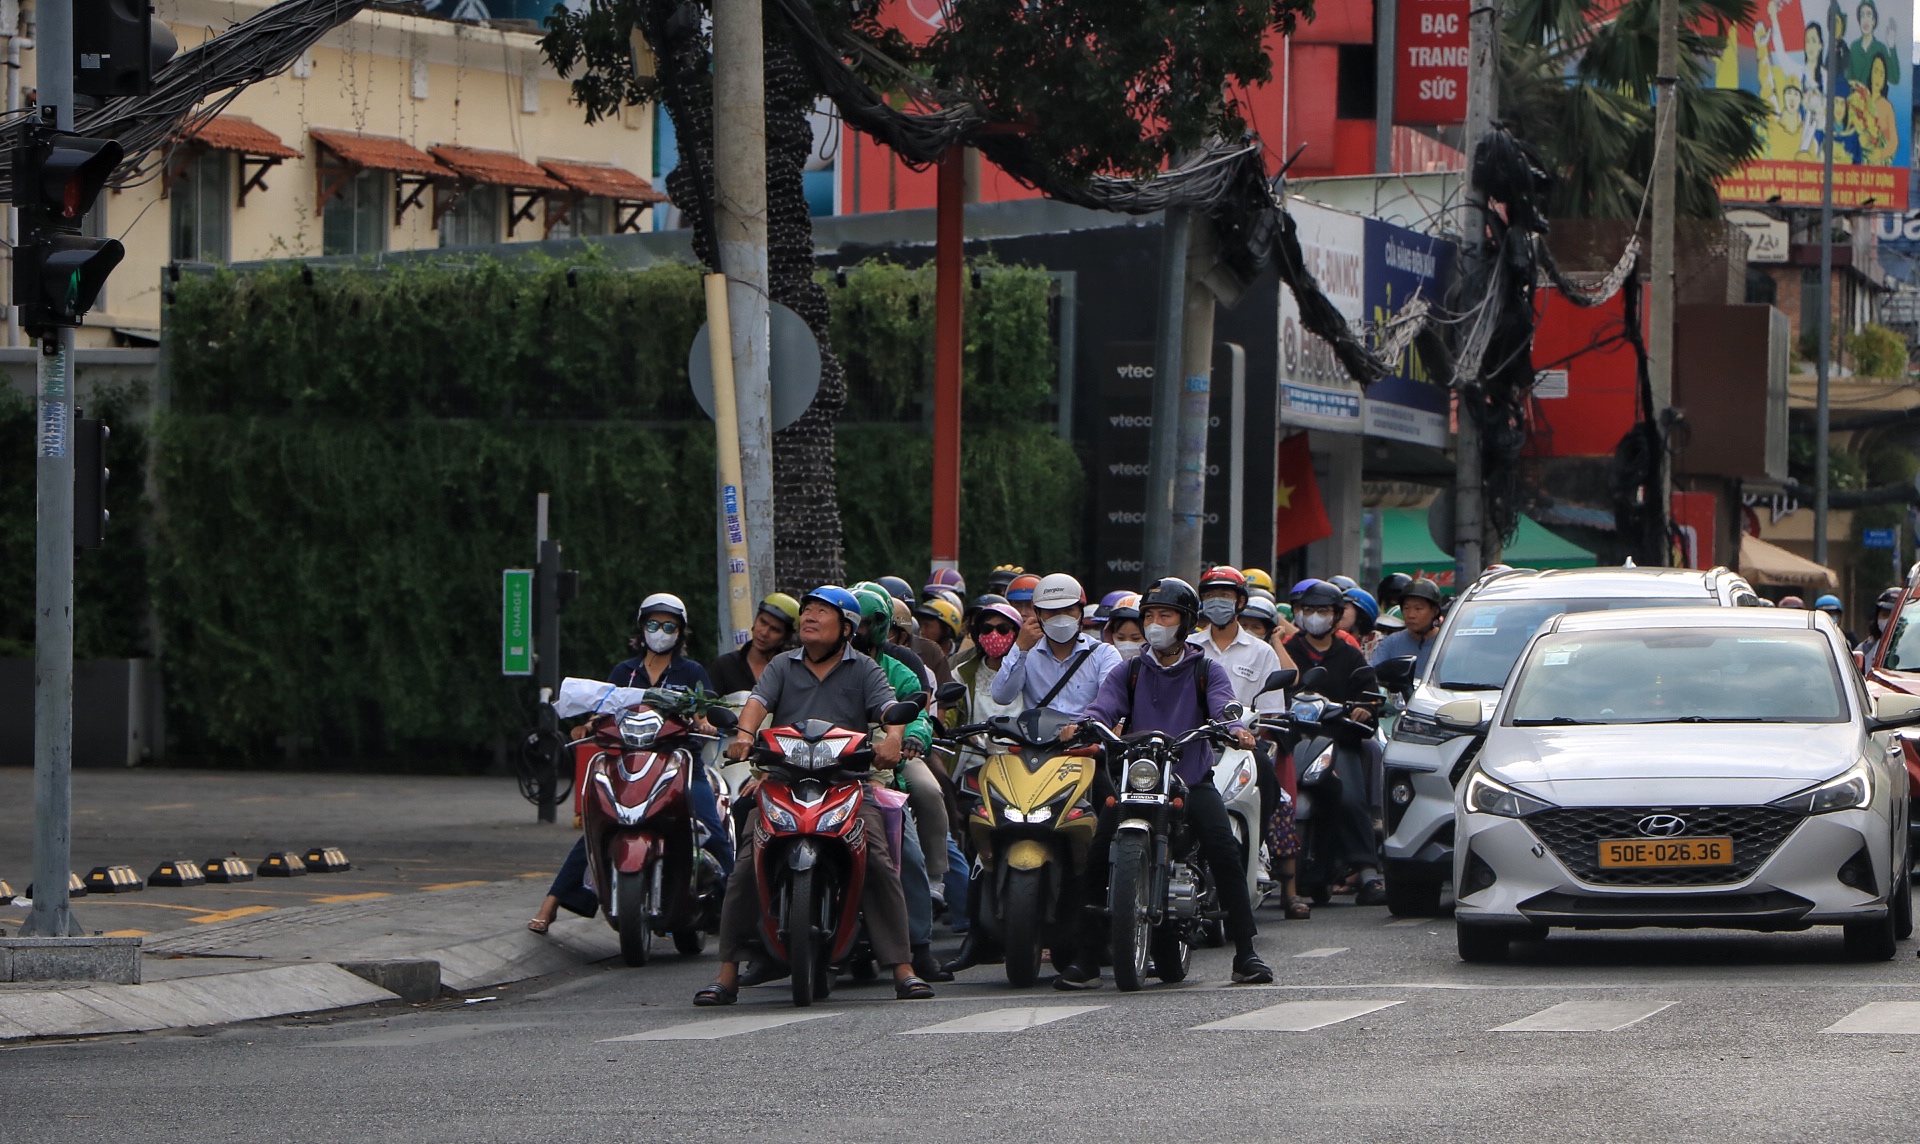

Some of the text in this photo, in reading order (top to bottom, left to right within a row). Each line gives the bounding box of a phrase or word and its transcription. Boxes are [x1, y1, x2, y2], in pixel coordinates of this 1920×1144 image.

[1421, 13, 1458, 38] BẠC
[1408, 46, 1468, 67] TRANG
[1419, 75, 1456, 100] SỨC
[1611, 843, 1721, 862] 50E-026.36
